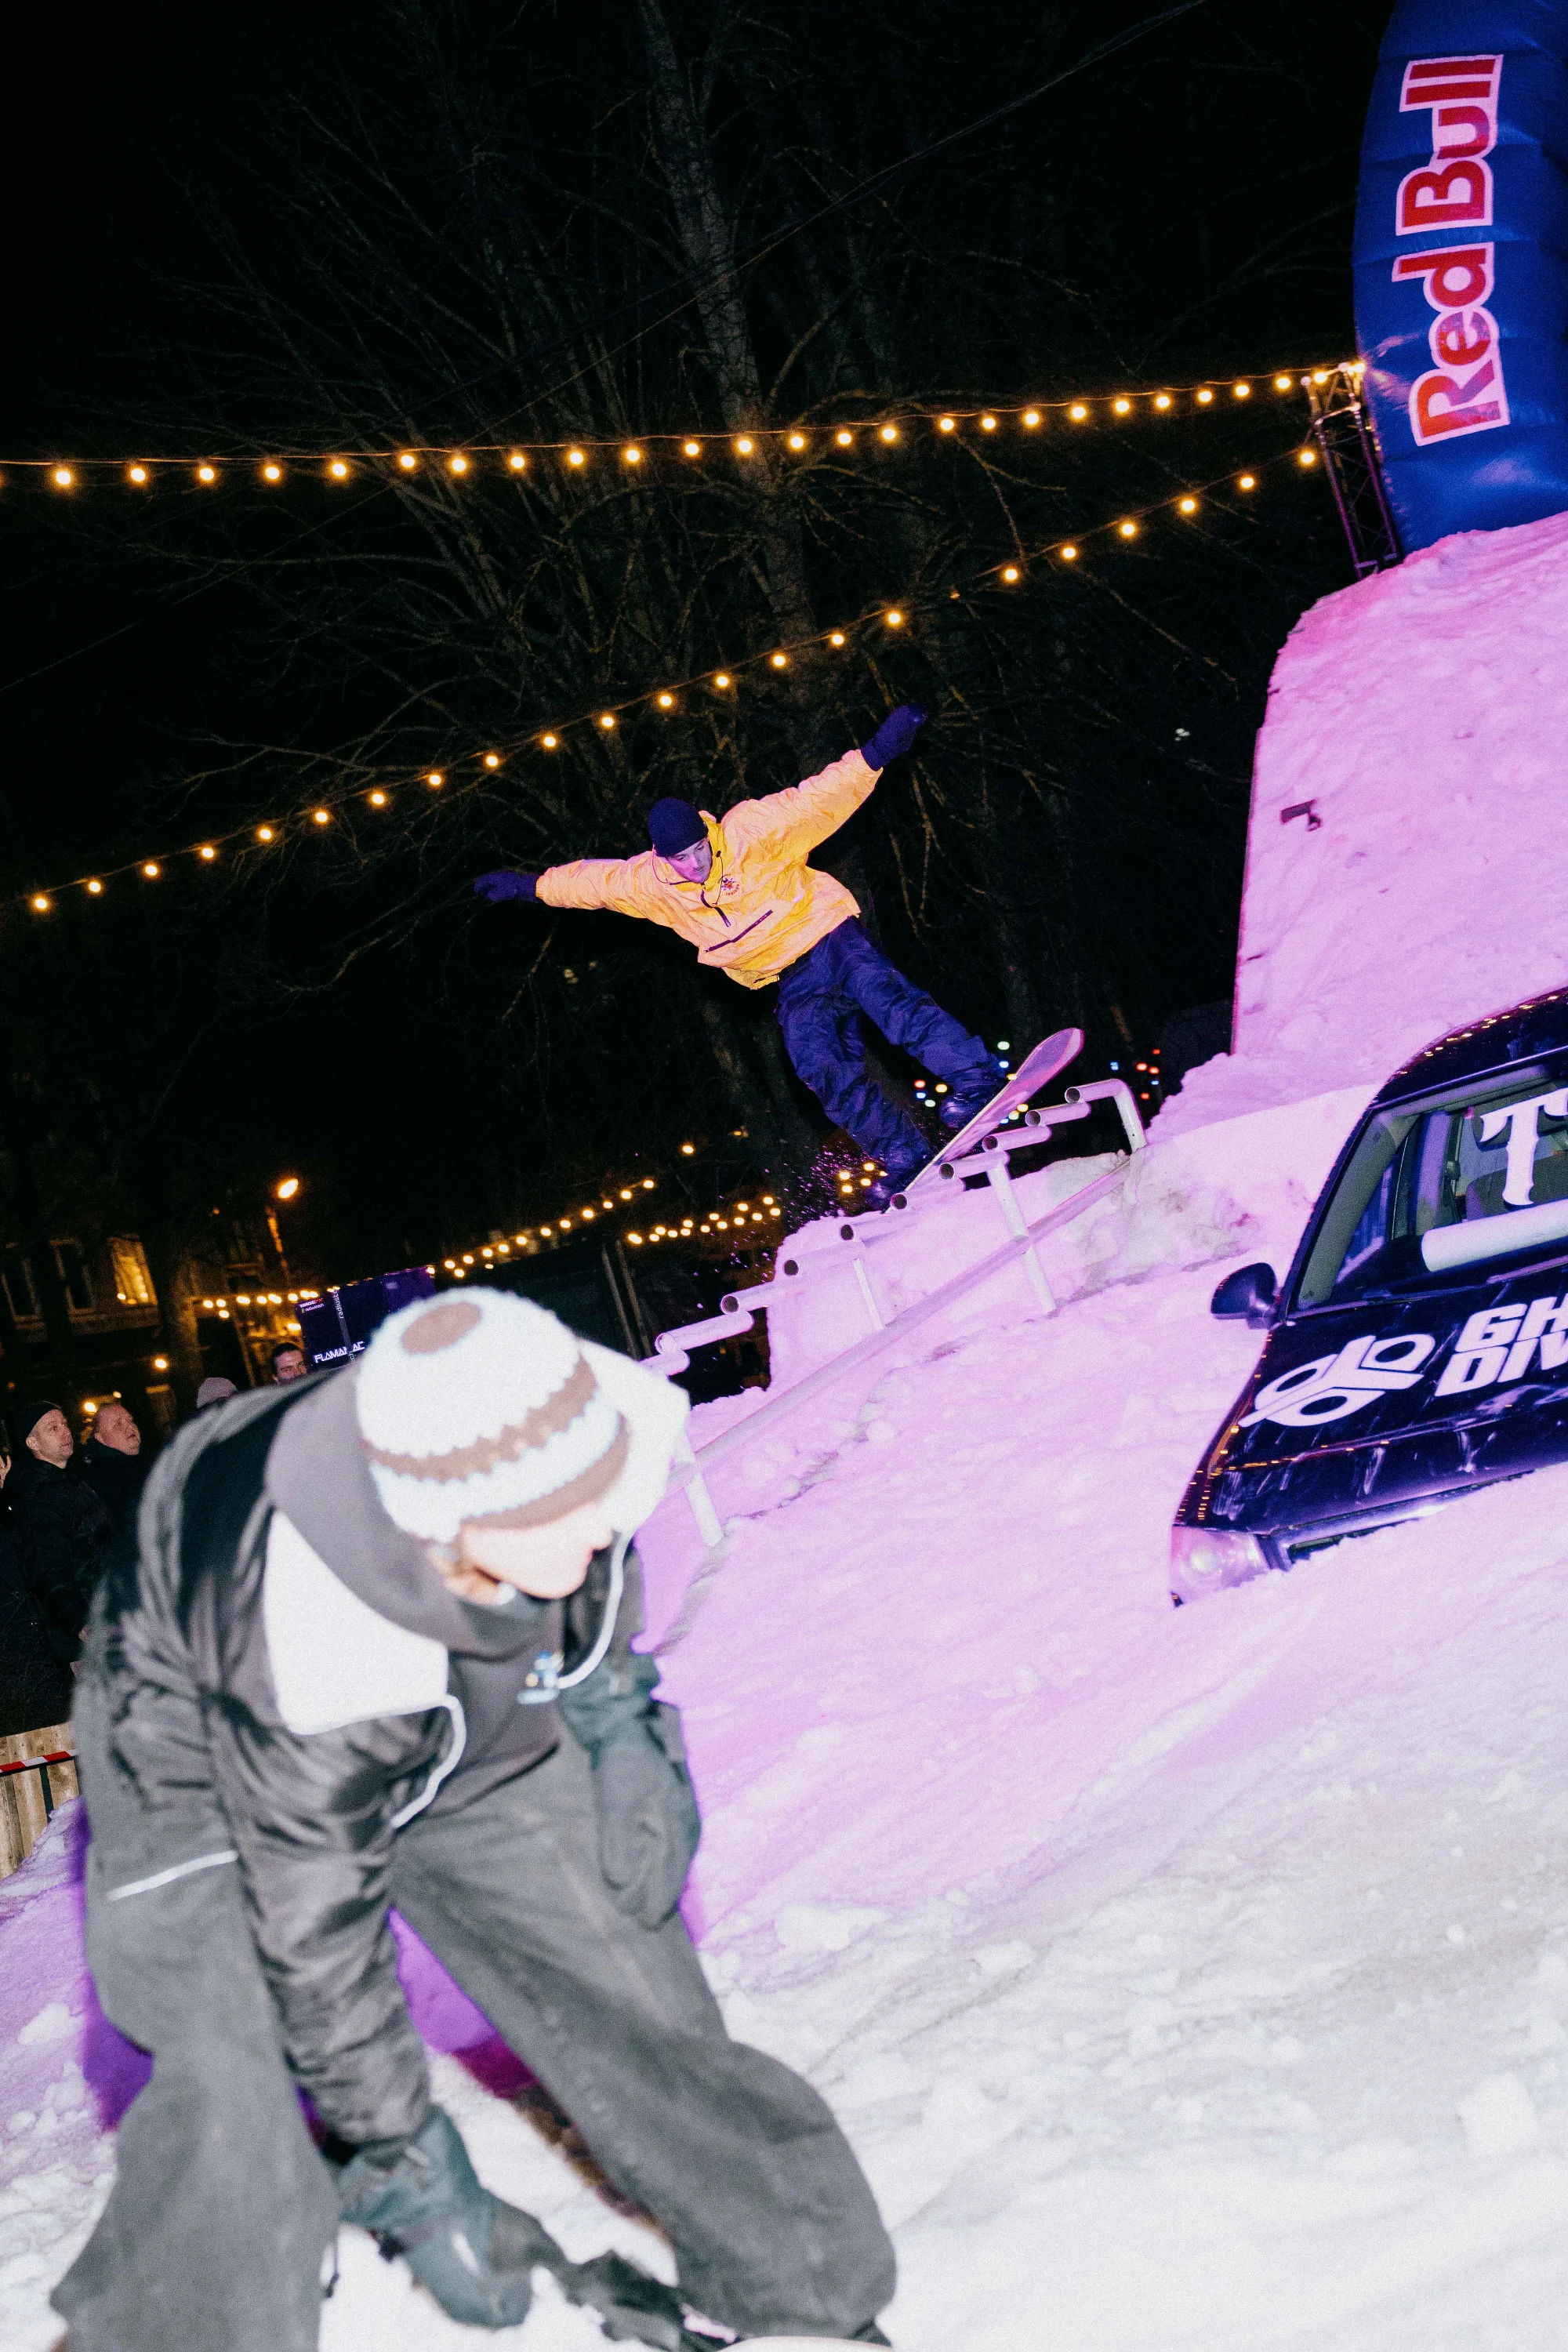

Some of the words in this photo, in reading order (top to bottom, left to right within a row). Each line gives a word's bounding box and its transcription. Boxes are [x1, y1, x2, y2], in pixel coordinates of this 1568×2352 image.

[1398, 56, 1501, 233] Bull
[1394, 245, 1506, 443] Red
[314, 1341, 365, 1363] FLAMAAC
